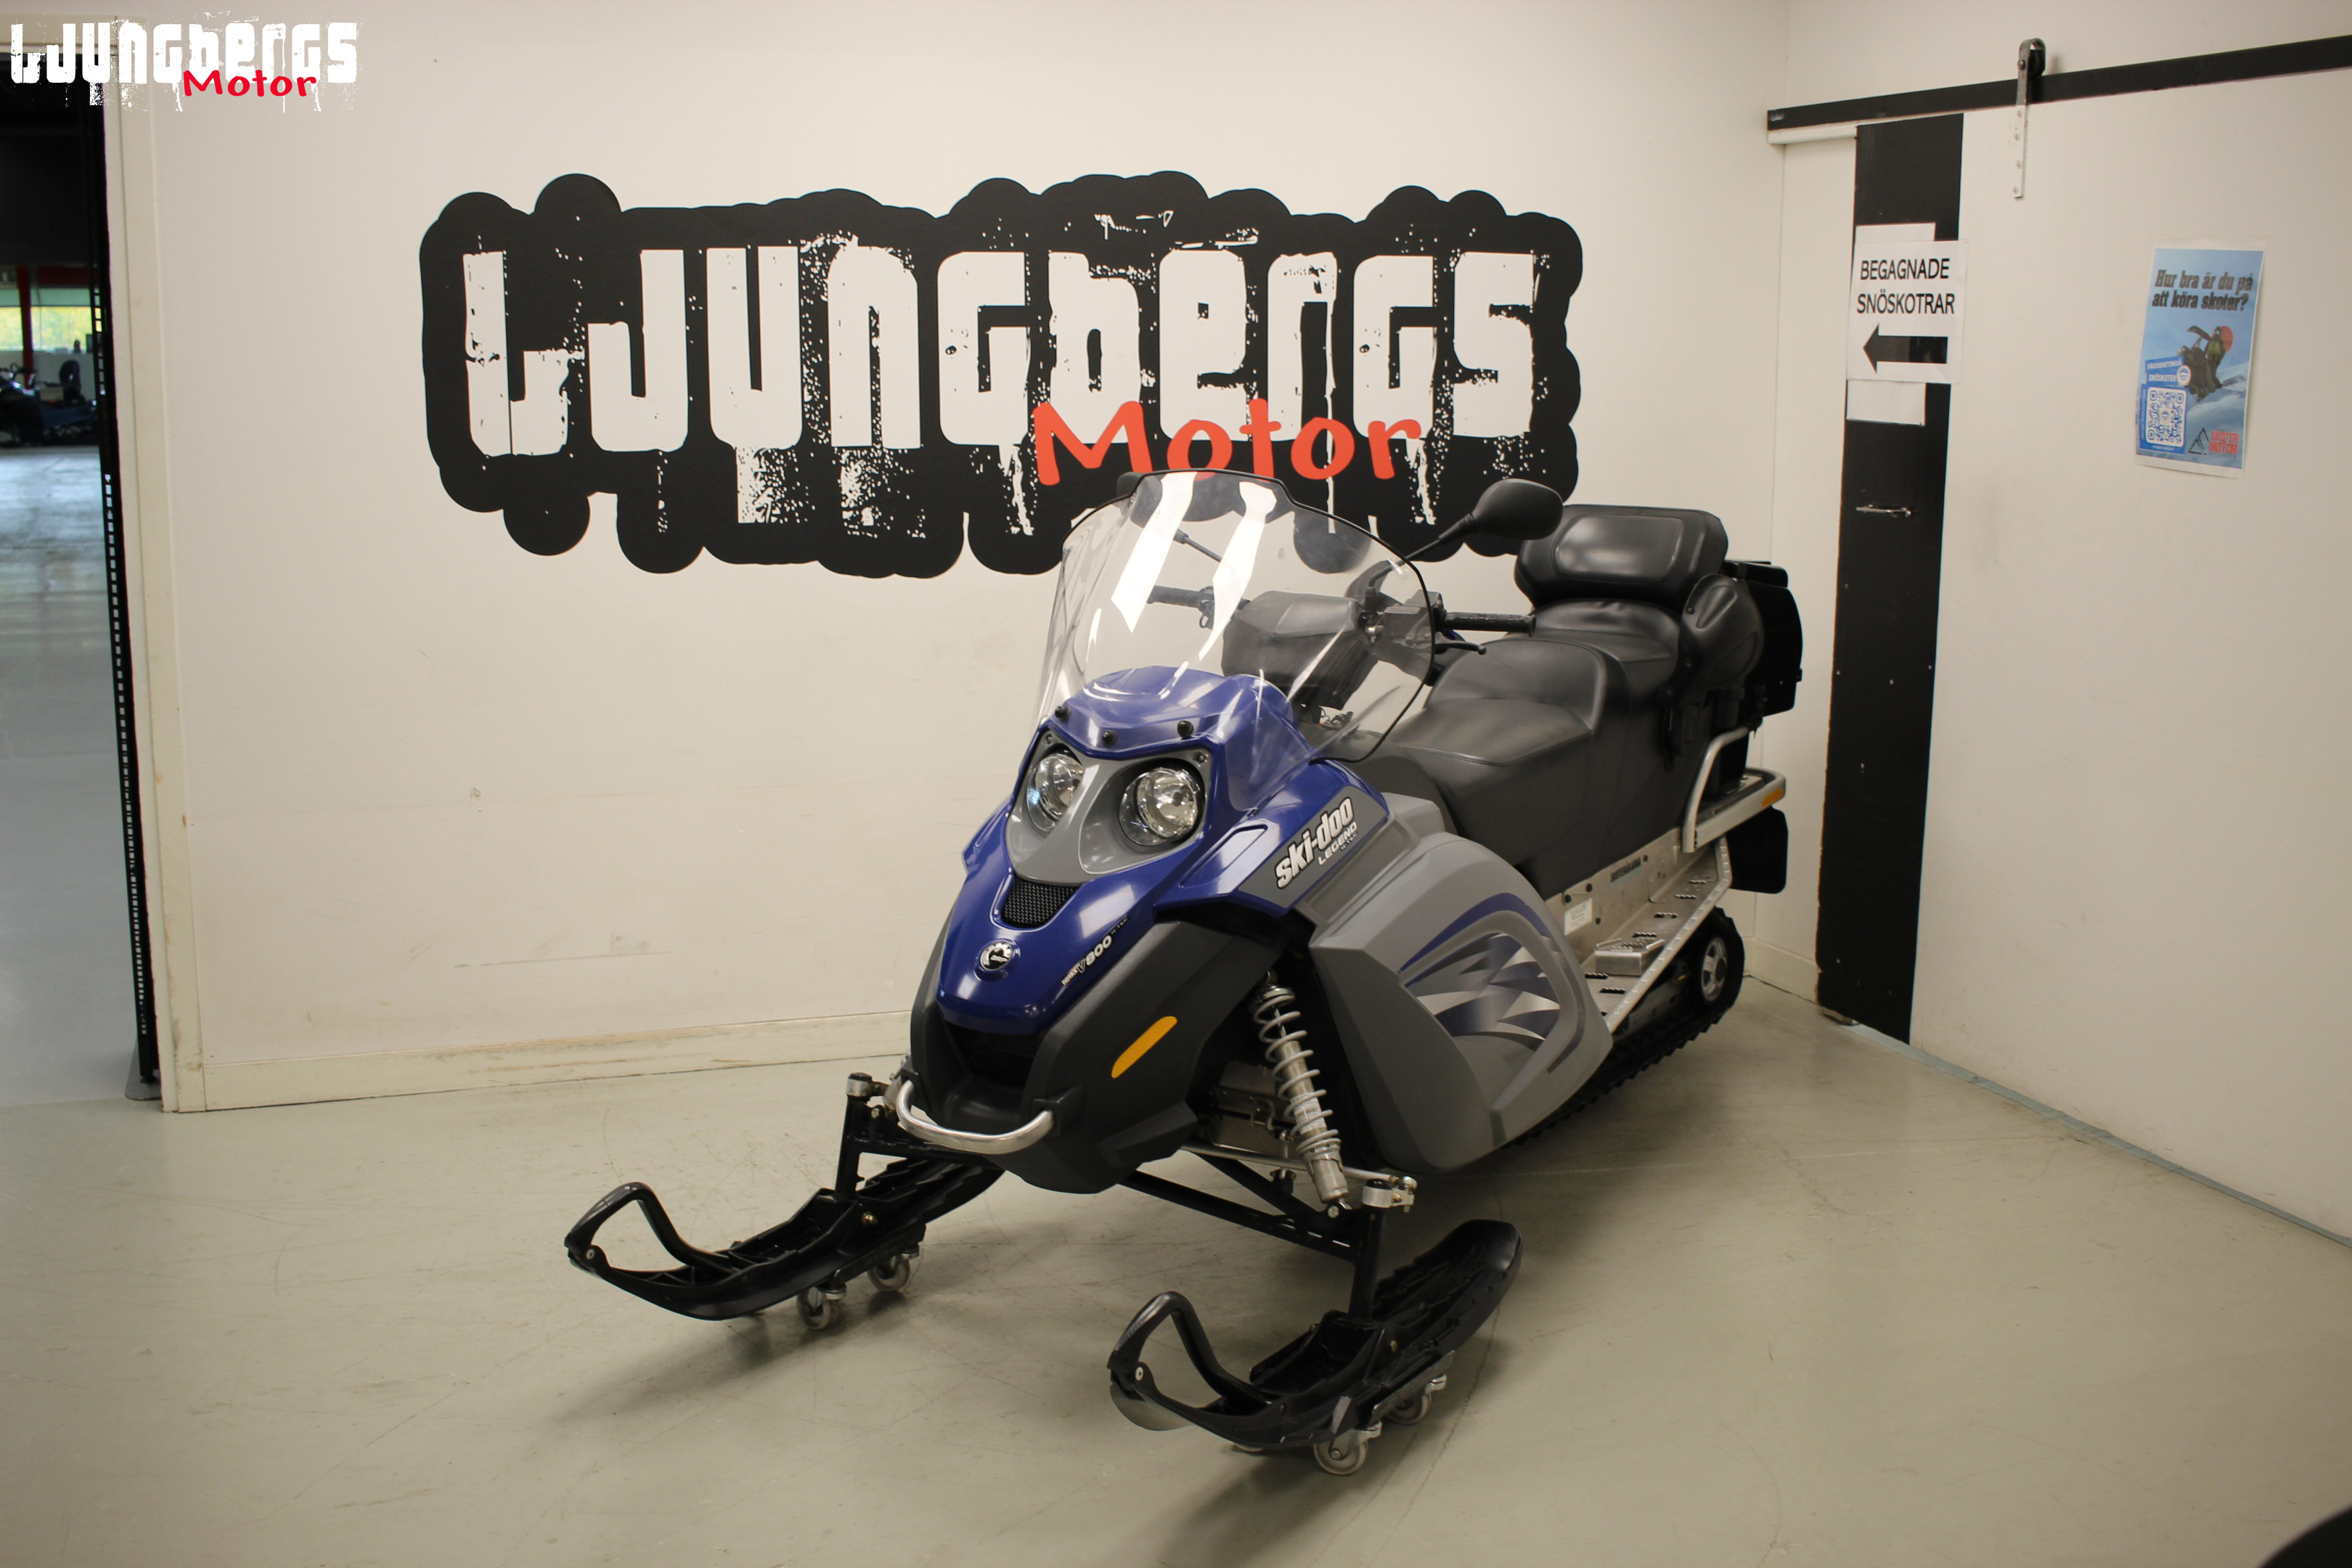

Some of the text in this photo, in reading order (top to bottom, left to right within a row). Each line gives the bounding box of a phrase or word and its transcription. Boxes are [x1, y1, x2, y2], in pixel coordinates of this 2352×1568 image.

[1860, 258, 1950, 280] BEGAGNADE
[2155, 269, 2253, 295] Hur bra är du på
[1856, 288, 1955, 314] SNÖSKOTRAR
[2152, 290, 2249, 311] att köra skoter?
[1032, 398, 1422, 486] Motor
[1318, 821, 1357, 865] LEGEND
